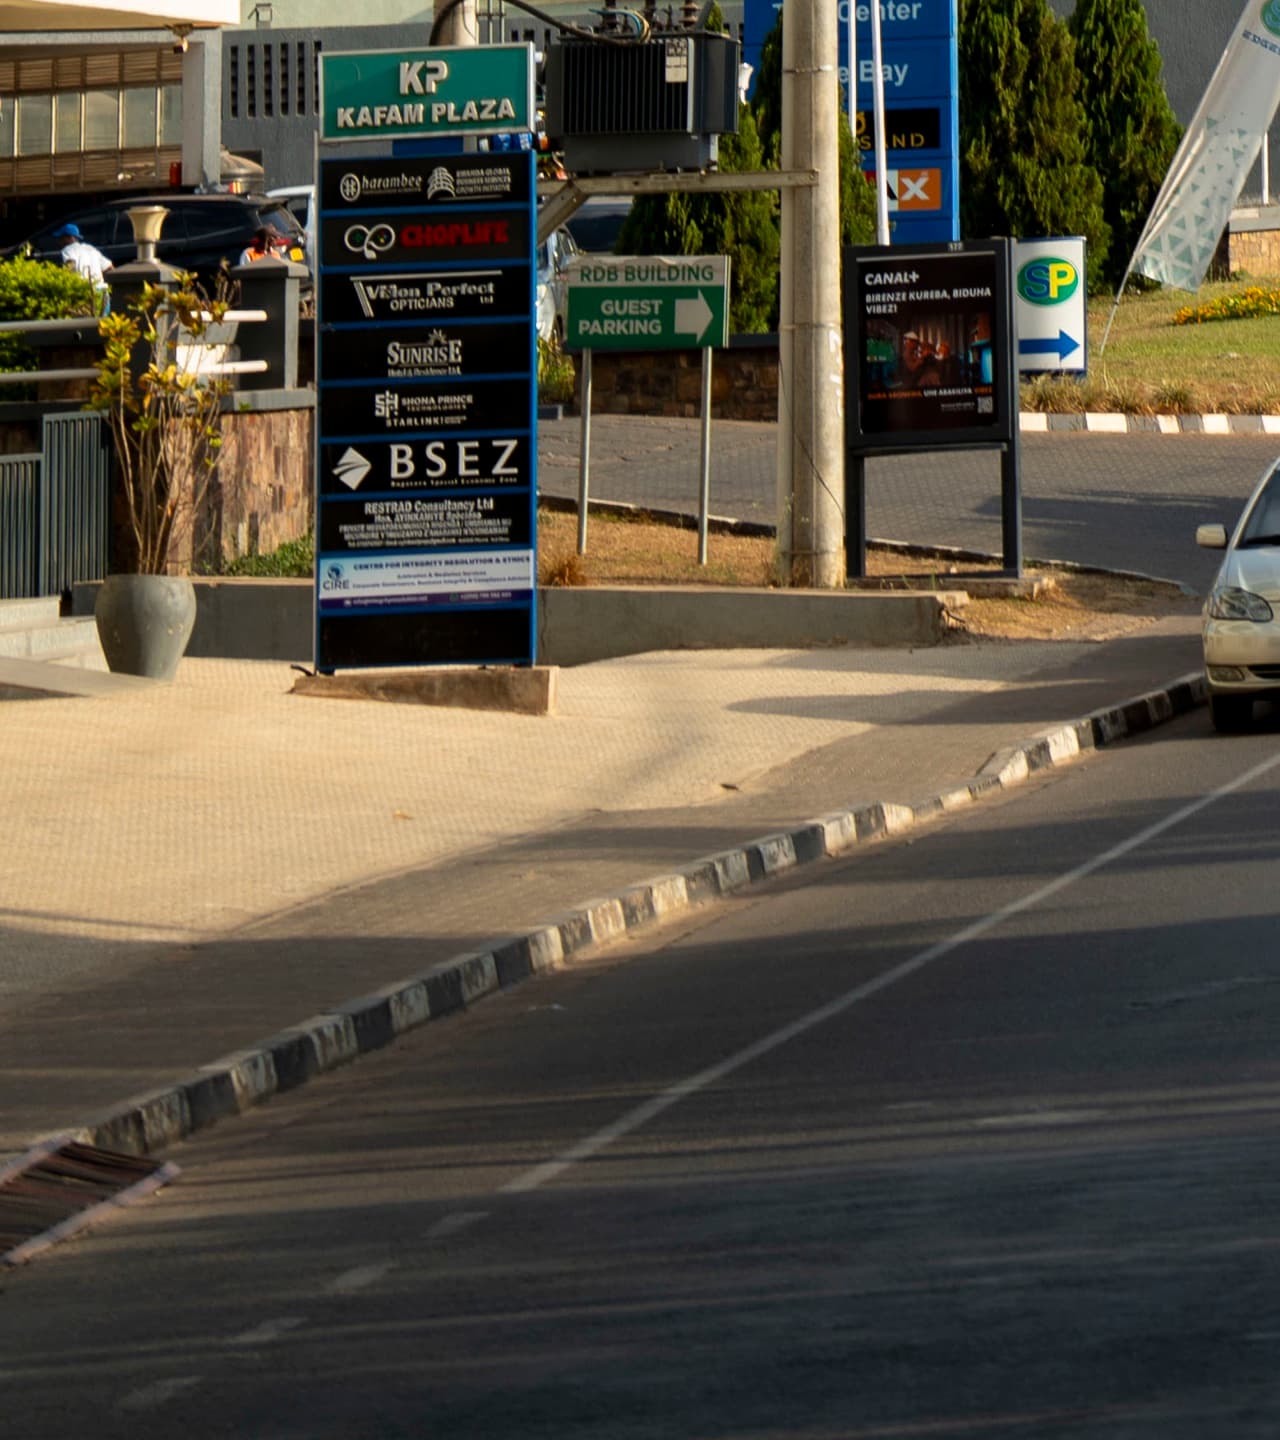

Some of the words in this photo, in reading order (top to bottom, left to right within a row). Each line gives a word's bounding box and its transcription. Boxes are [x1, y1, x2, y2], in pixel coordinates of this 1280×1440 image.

[838, 0, 922, 24] Ceter
[399, 59, 449, 95] KP
[859, 59, 909, 87] Bay
[336, 103, 425, 129] KAFAM
[431, 98, 517, 123] PLAZA
[362, 173, 423, 191] harambee
[580, 265, 618, 282] RDB
[624, 264, 714, 282] BUILDING
[864, 270, 920, 286] CANAL+
[1024, 263, 1076, 299] SP
[426, 282, 496, 298] Perfect
[390, 296, 455, 312] OPTICIANS
[600, 298, 663, 316] GUEST
[578, 318, 662, 335] PARKING
[387, 339, 463, 367] SUNRISE
[401, 396, 436, 406] SHONA
[437, 394, 474, 405] PRINCE
[386, 417, 441, 428] STARLINK
[389, 439, 519, 479] BSEZ
[364, 500, 412, 516] RESTRAD
[414, 497, 475, 514] Consultancy
[477, 495, 494, 511] Ltd
[322, 579, 350, 592] CIRE
